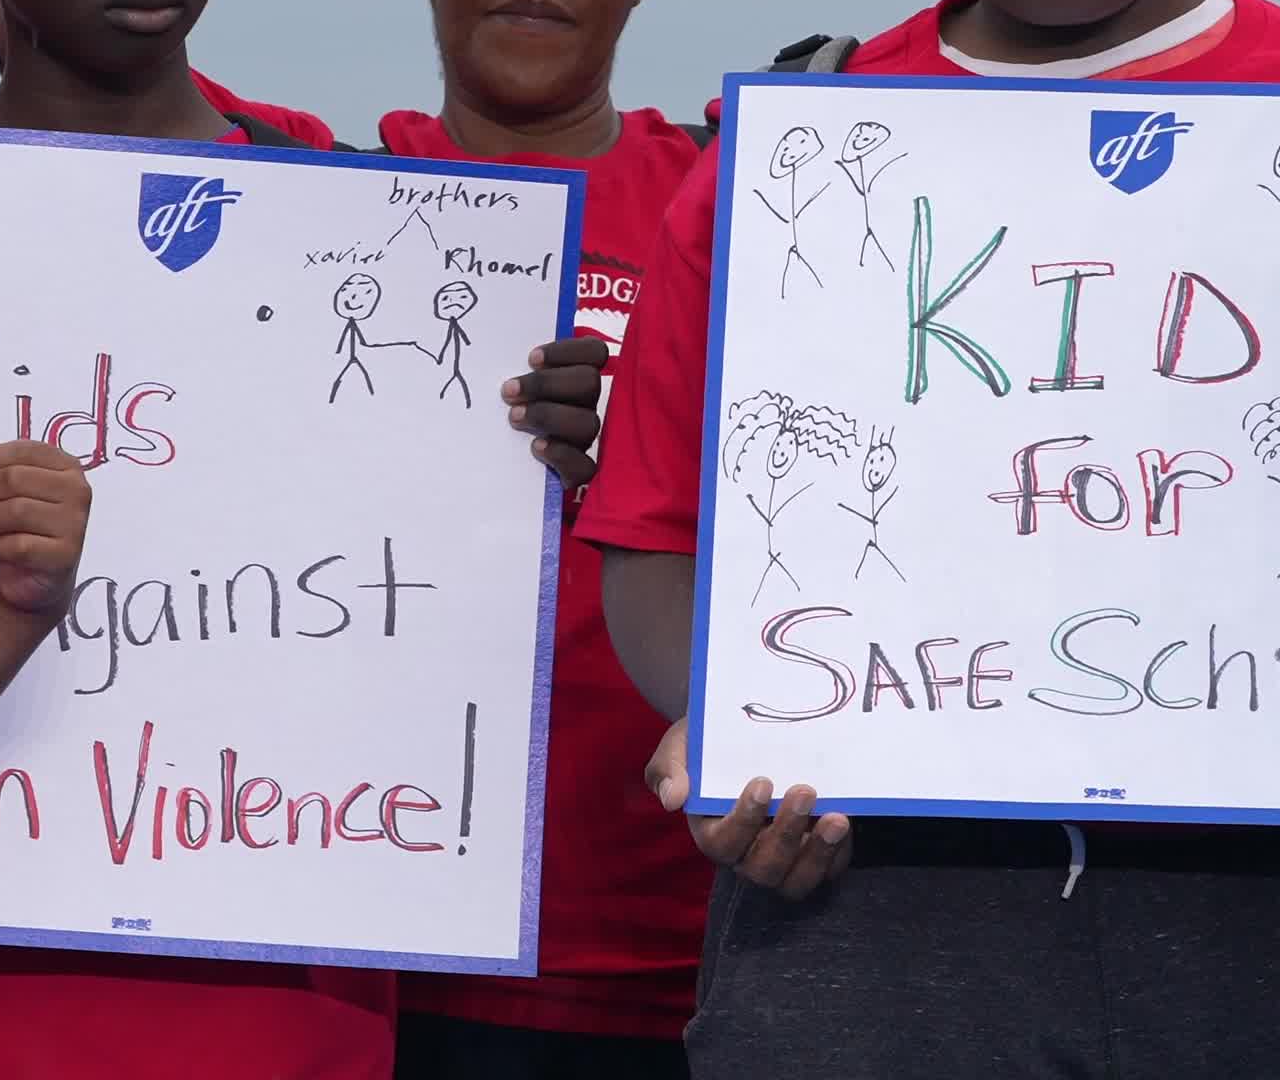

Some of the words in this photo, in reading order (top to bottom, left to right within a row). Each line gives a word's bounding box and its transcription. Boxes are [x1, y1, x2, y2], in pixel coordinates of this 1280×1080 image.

[389, 176, 519, 212] brothers
[741, 605, 1014, 722] SAFE
[93, 702, 478, 865] Violence!
